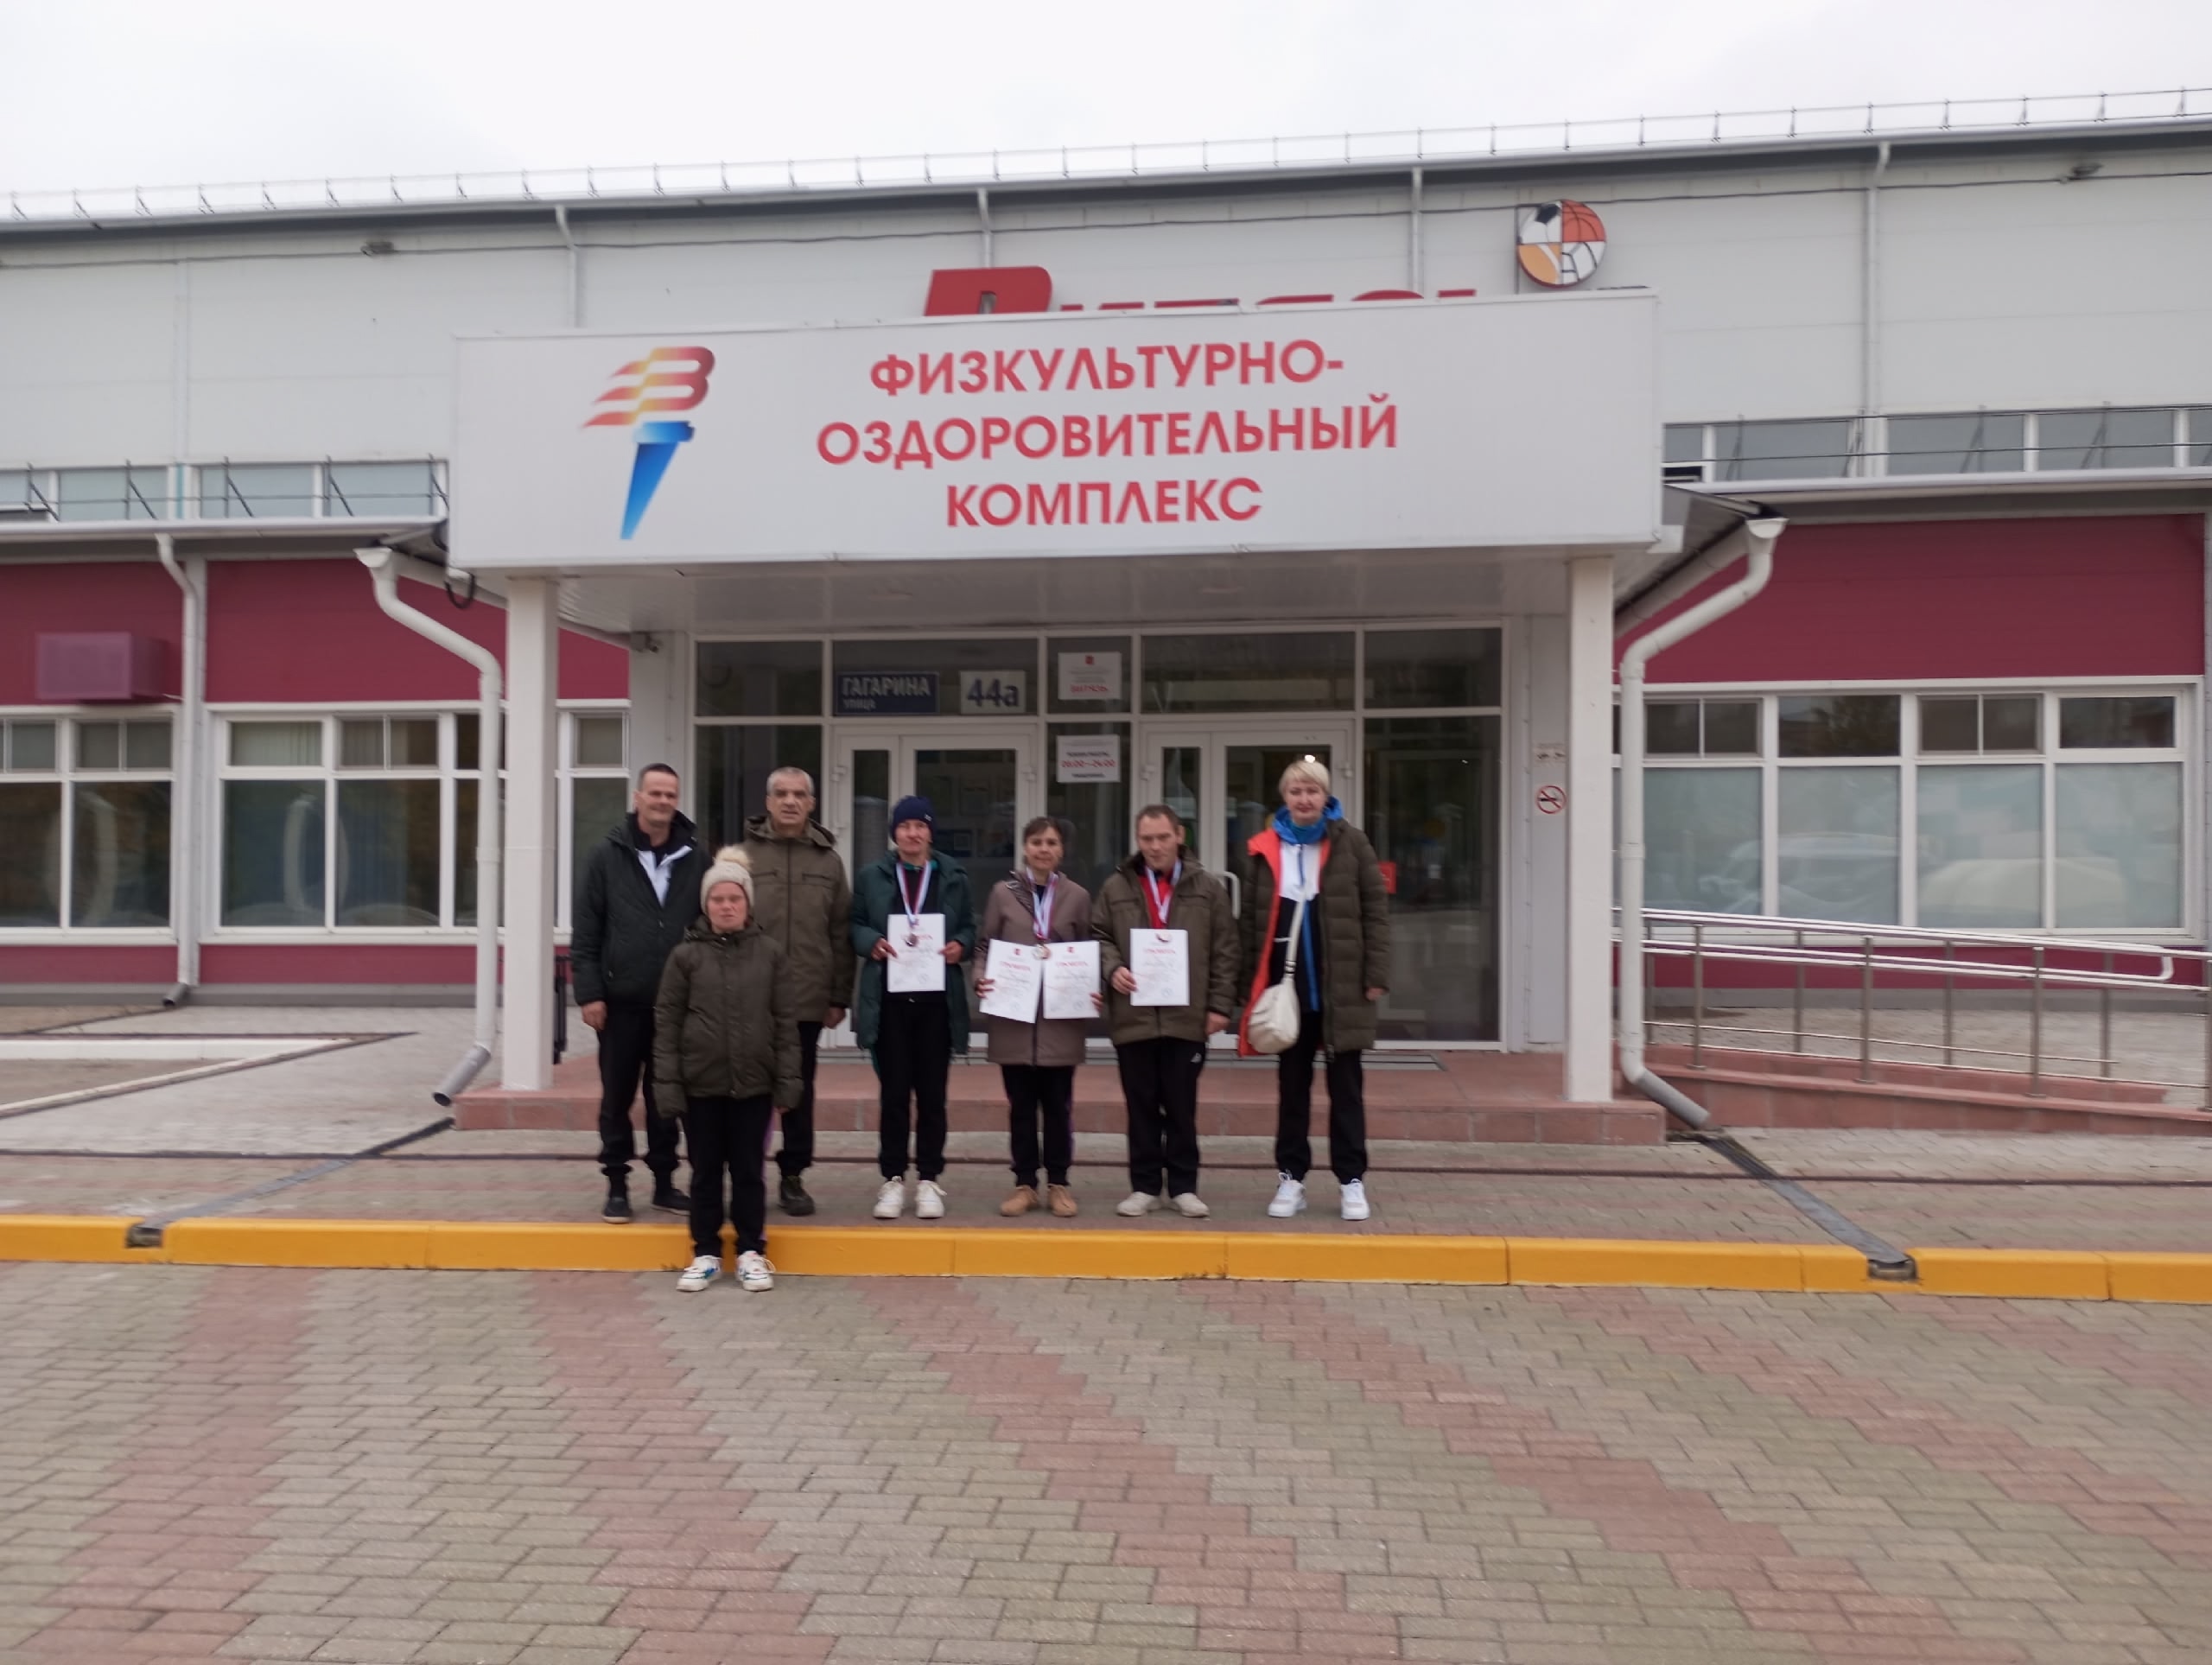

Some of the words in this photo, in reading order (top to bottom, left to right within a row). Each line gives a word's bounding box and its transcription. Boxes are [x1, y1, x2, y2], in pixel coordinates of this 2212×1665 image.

[870, 339, 1344, 397] ФИЗКУЛЬТУРНО-
[817, 393, 1397, 470] ОЗДОРОВИТЕЛЬНЫЙ
[947, 477, 1262, 527] КОМПЛЕКС
[842, 677, 931, 697] ГАГАРИНА
